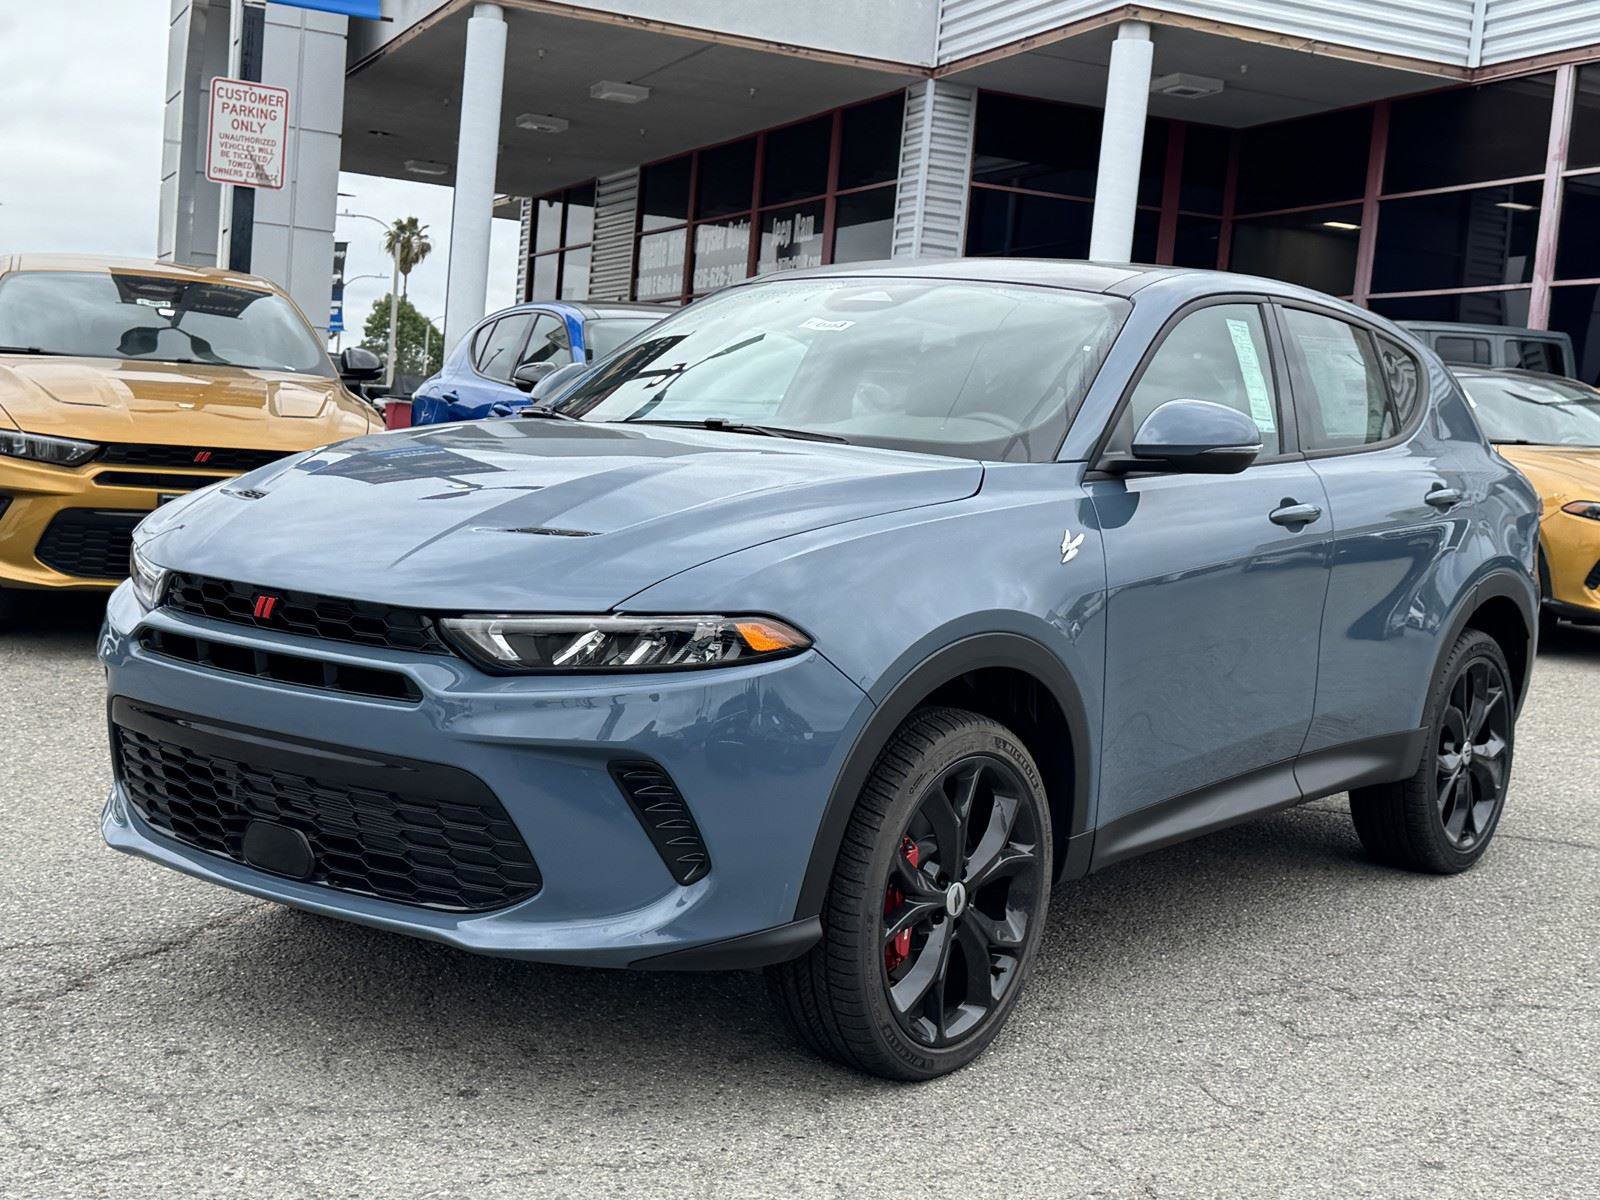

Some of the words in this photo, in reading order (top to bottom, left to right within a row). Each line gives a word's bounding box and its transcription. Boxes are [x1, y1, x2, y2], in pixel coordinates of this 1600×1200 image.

[216, 87, 284, 107] CUSTOMER
[221, 102, 277, 121] PARKING
[231, 118, 266, 133] ONLY
[218, 133, 276, 147] UNAUTHORIZED
[219, 141, 255, 152] VEHICLES
[258, 147, 274, 155] WILL
[220, 149, 230, 158] BE
[228, 160, 252, 169] TOWED
[771, 217, 792, 249] Jeep
[793, 213, 814, 243] Ram
